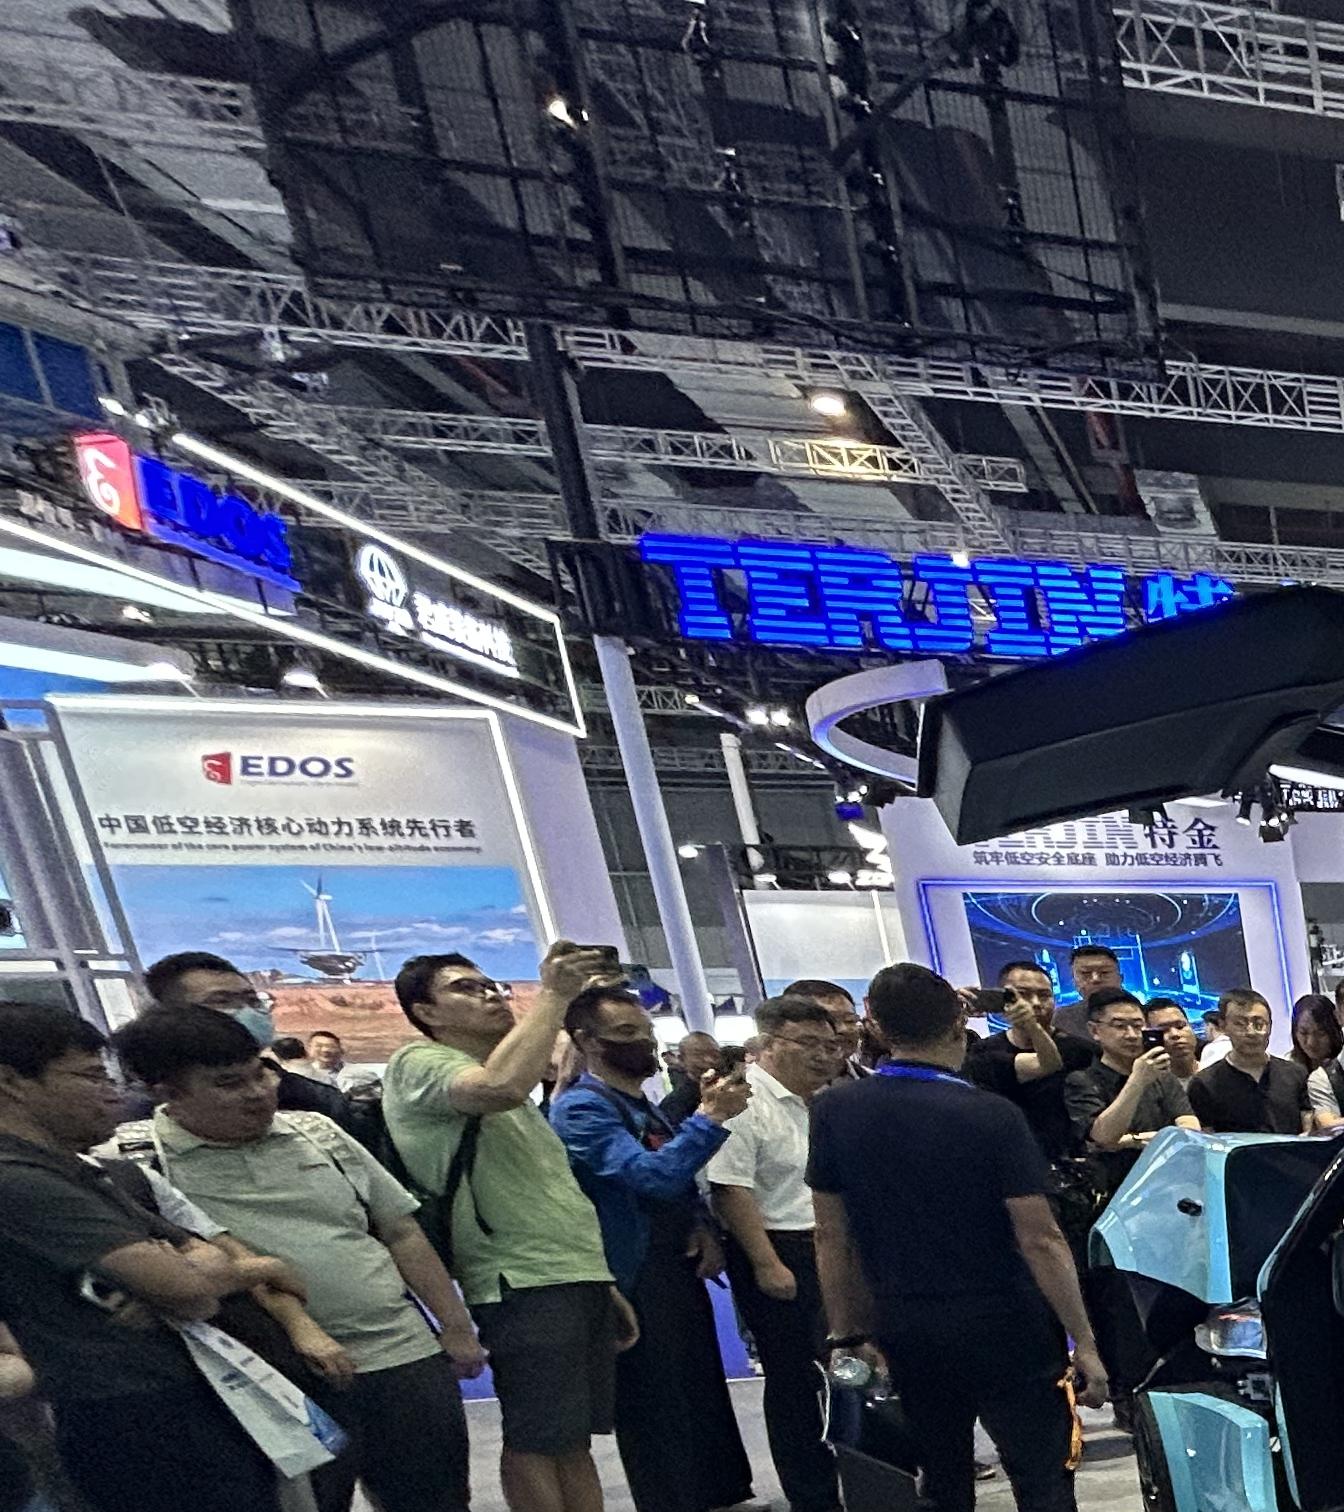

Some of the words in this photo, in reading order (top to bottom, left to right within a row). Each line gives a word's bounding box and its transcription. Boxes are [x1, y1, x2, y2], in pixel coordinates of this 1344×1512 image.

[239, 755, 355, 778] EDOS
[98, 814, 477, 840] 中国低空经济核心动力系统先行者
[973, 851, 1098, 867] 筑牢低空安全底座
